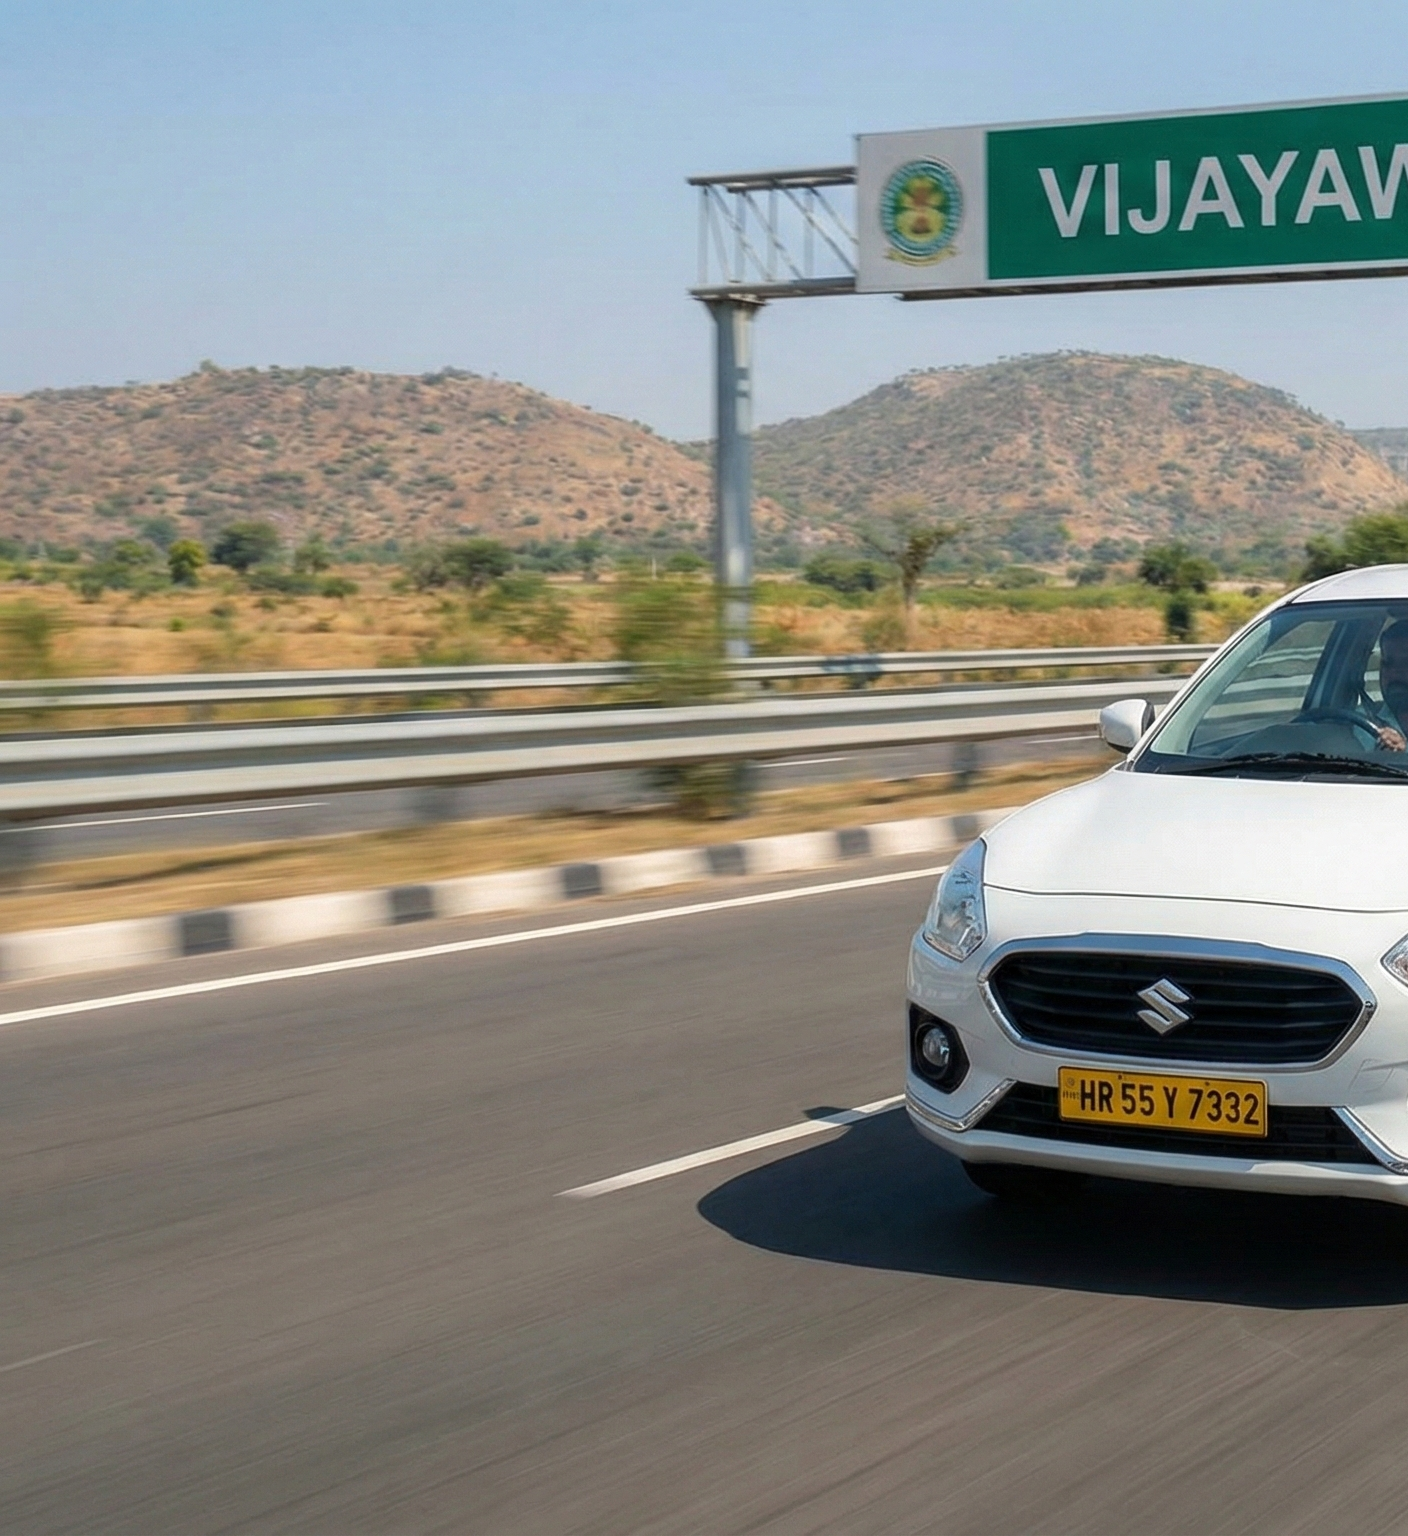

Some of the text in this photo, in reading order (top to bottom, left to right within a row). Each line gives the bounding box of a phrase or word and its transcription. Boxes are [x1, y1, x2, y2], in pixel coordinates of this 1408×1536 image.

[1080, 1079, 1260, 1126] HR 55 Y 7332
